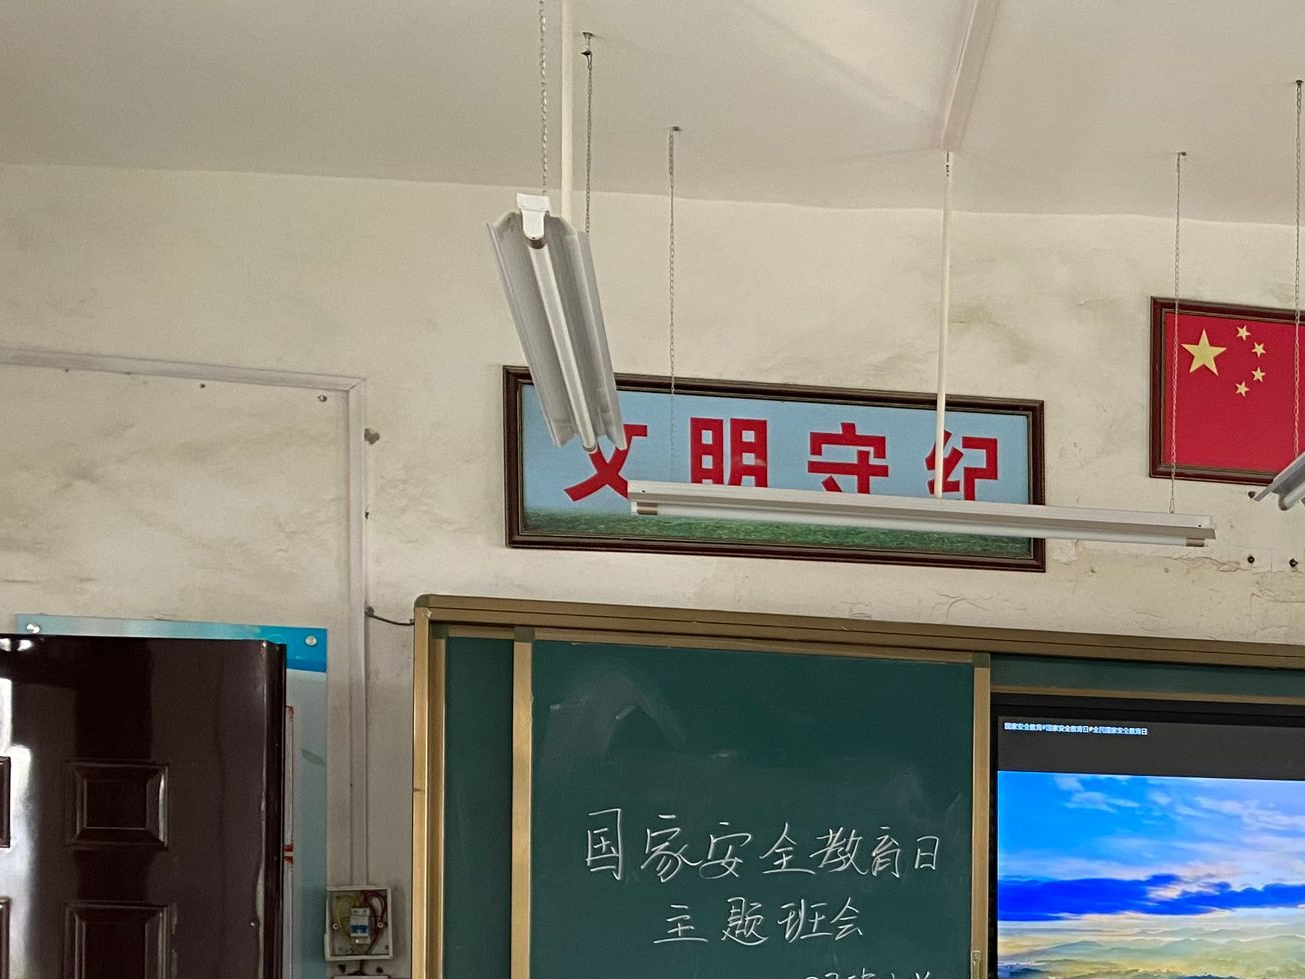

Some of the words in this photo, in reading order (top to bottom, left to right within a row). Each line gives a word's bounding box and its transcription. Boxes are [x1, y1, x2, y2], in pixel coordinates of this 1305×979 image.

[563, 416, 998, 503] 文明守纪
[585, 808, 940, 883] 国家安全教育日
[654, 897, 863, 946] 主题班会
